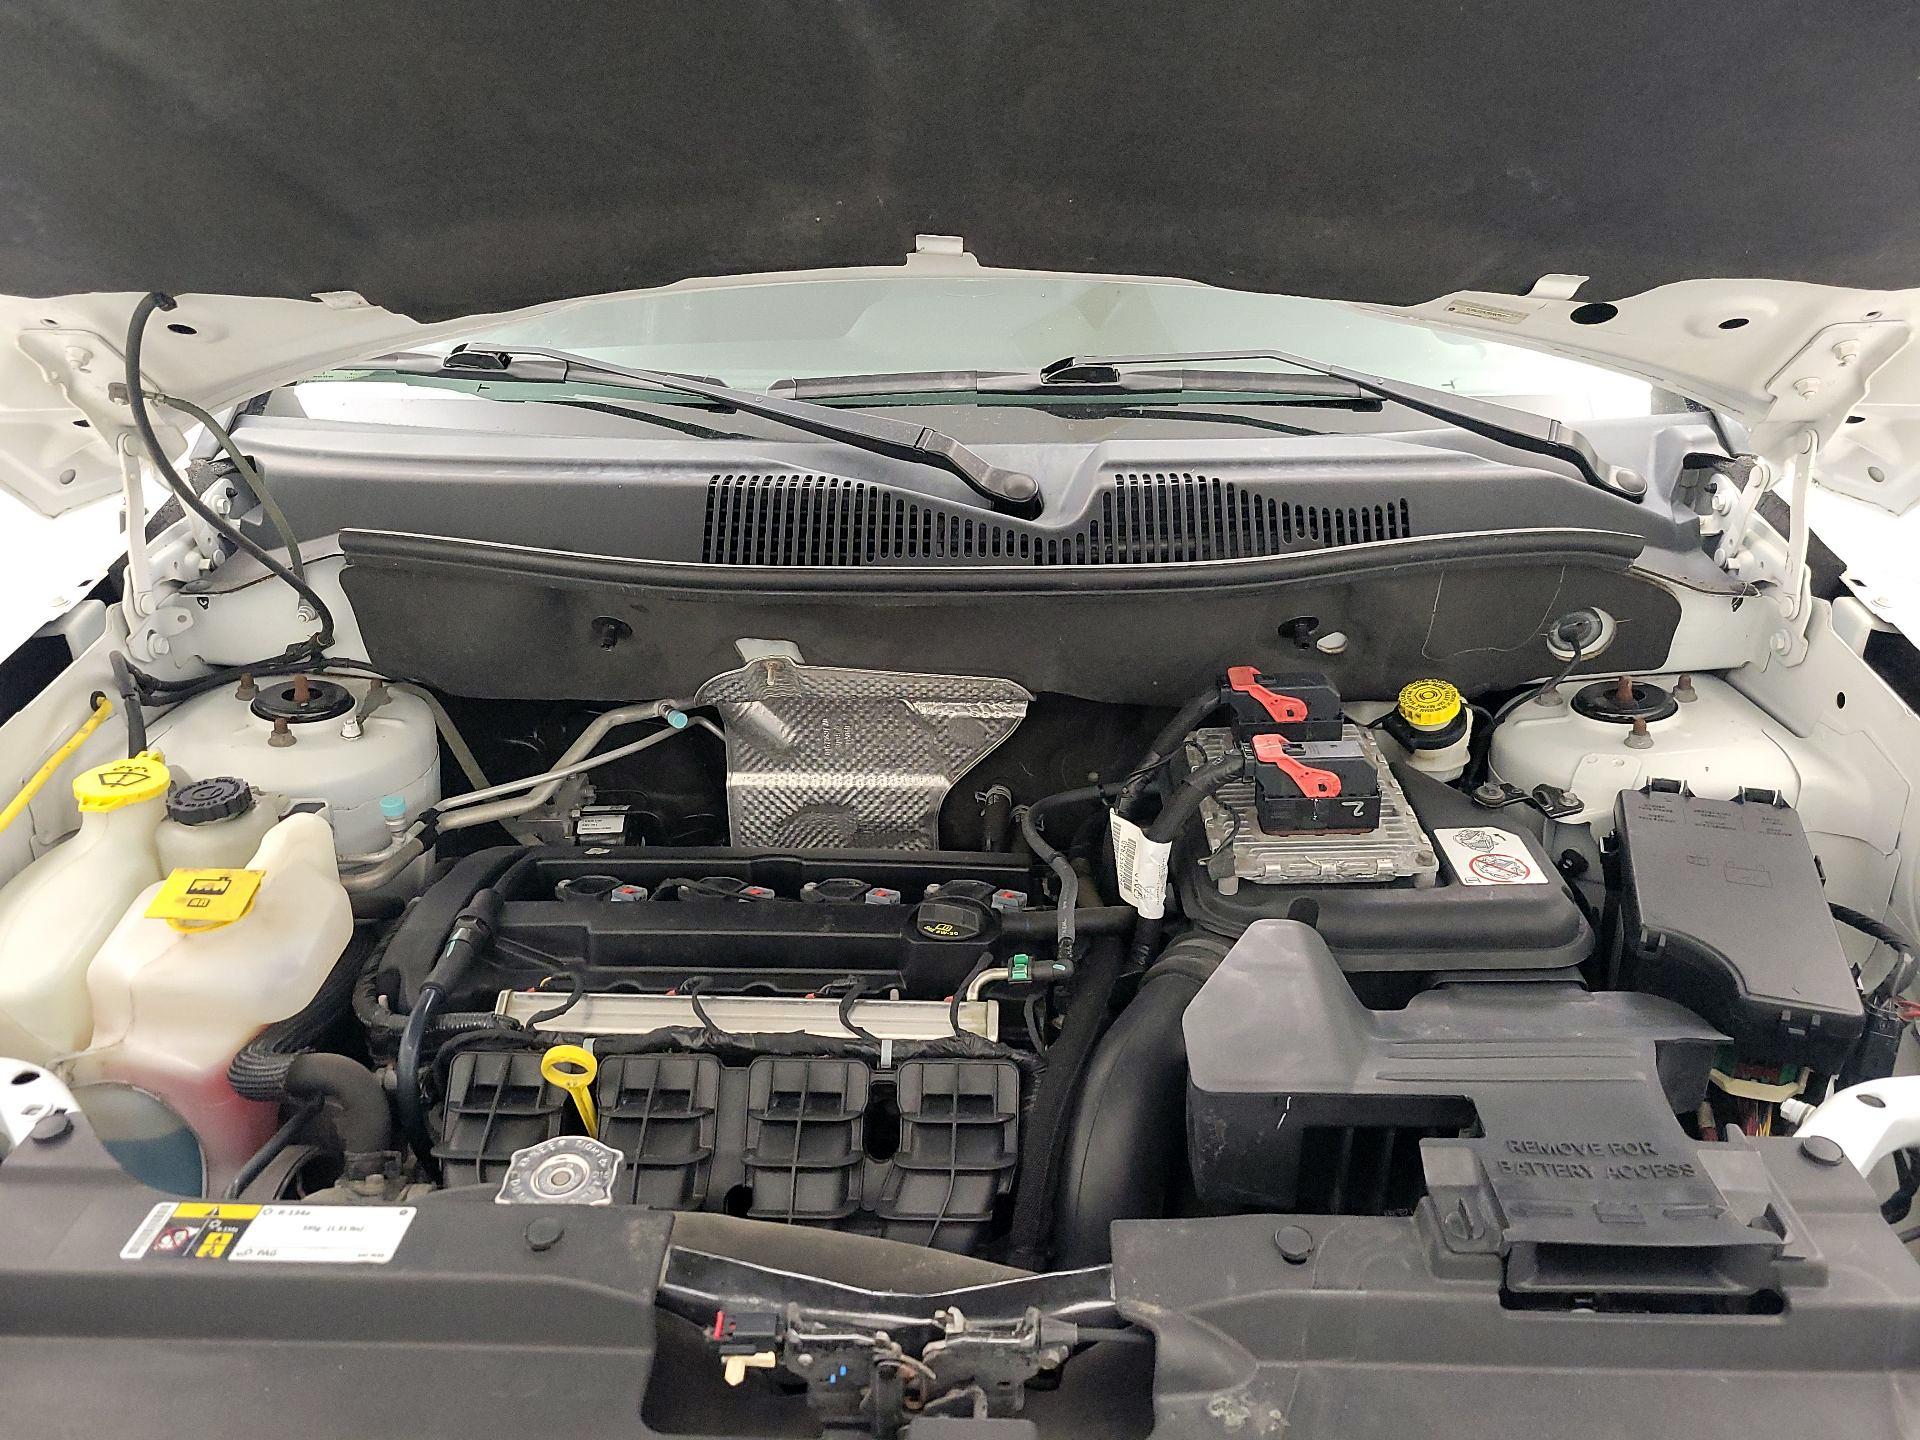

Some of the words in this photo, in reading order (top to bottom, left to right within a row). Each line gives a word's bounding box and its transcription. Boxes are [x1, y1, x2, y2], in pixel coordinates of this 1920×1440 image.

[1505, 1139, 1605, 1157] REMOVE
[1607, 1141, 1659, 1156] FOR
[1497, 1160, 1595, 1179] BATTERY
[1605, 1163, 1696, 1180] ACCESS
